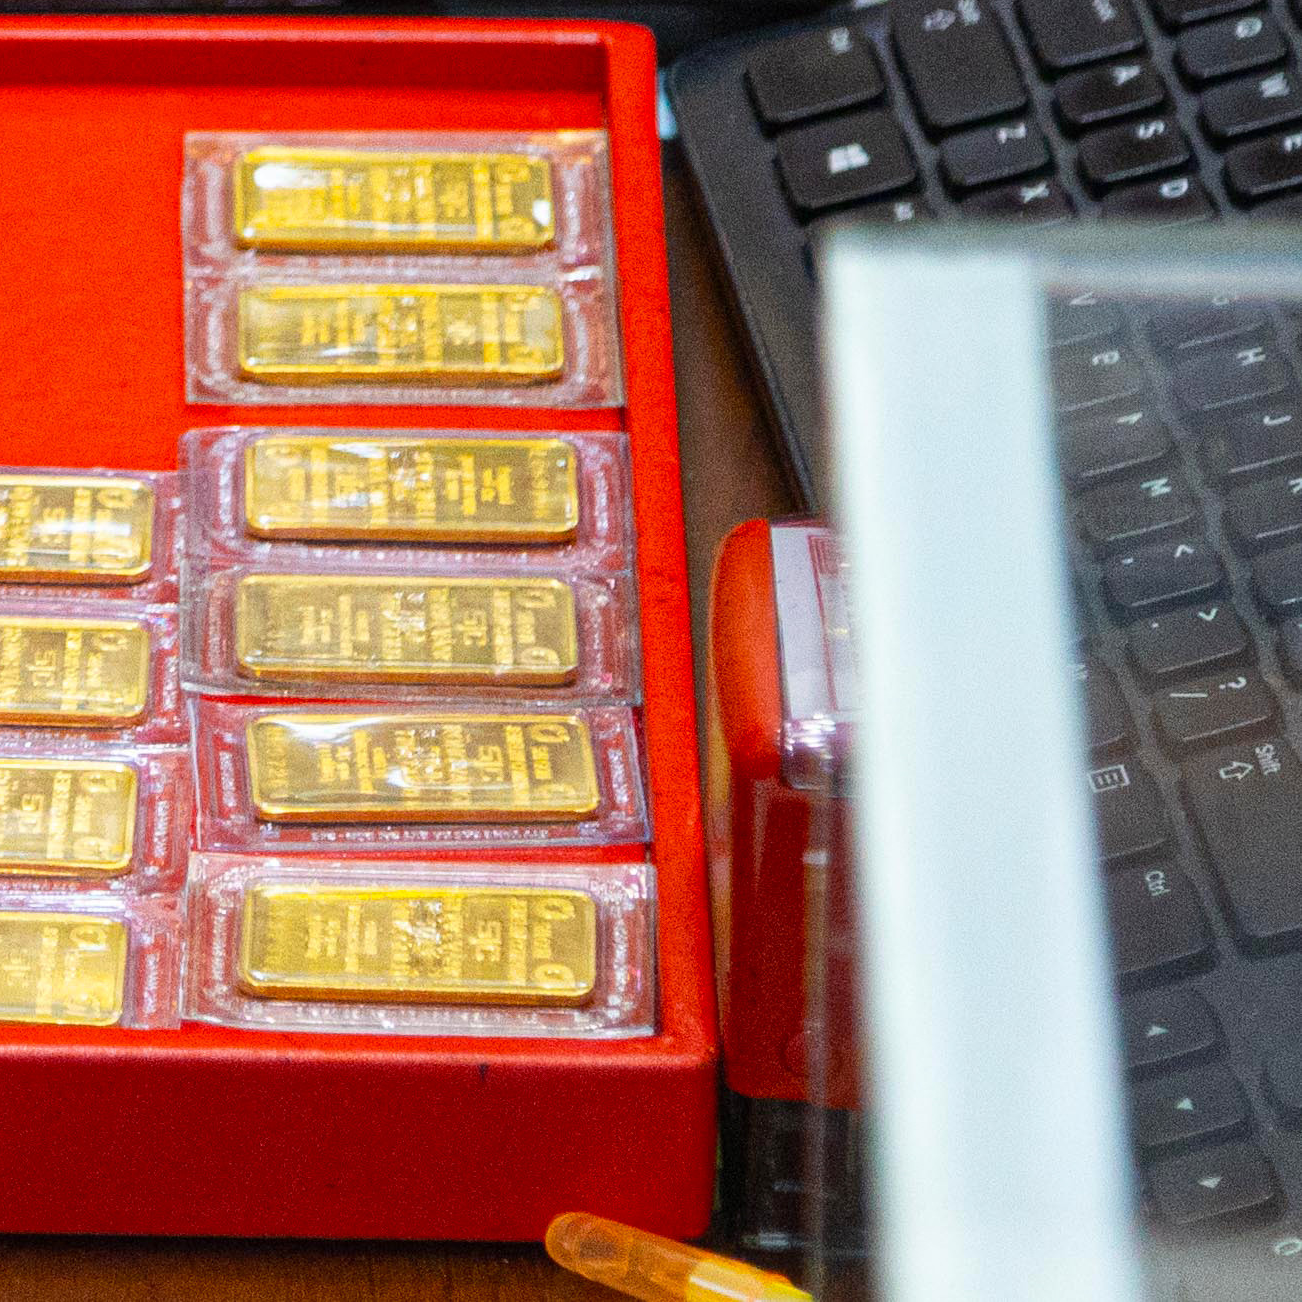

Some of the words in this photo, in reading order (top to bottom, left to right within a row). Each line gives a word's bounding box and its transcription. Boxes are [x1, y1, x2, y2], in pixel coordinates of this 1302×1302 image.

[1111, 64, 1141, 87] A
[997, 122, 1027, 146] Z
[1136, 118, 1166, 139] S
[1020, 181, 1050, 204] X
[1158, 177, 1190, 199] D
[1237, 347, 1267, 367] H
[1140, 477, 1172, 497] M
